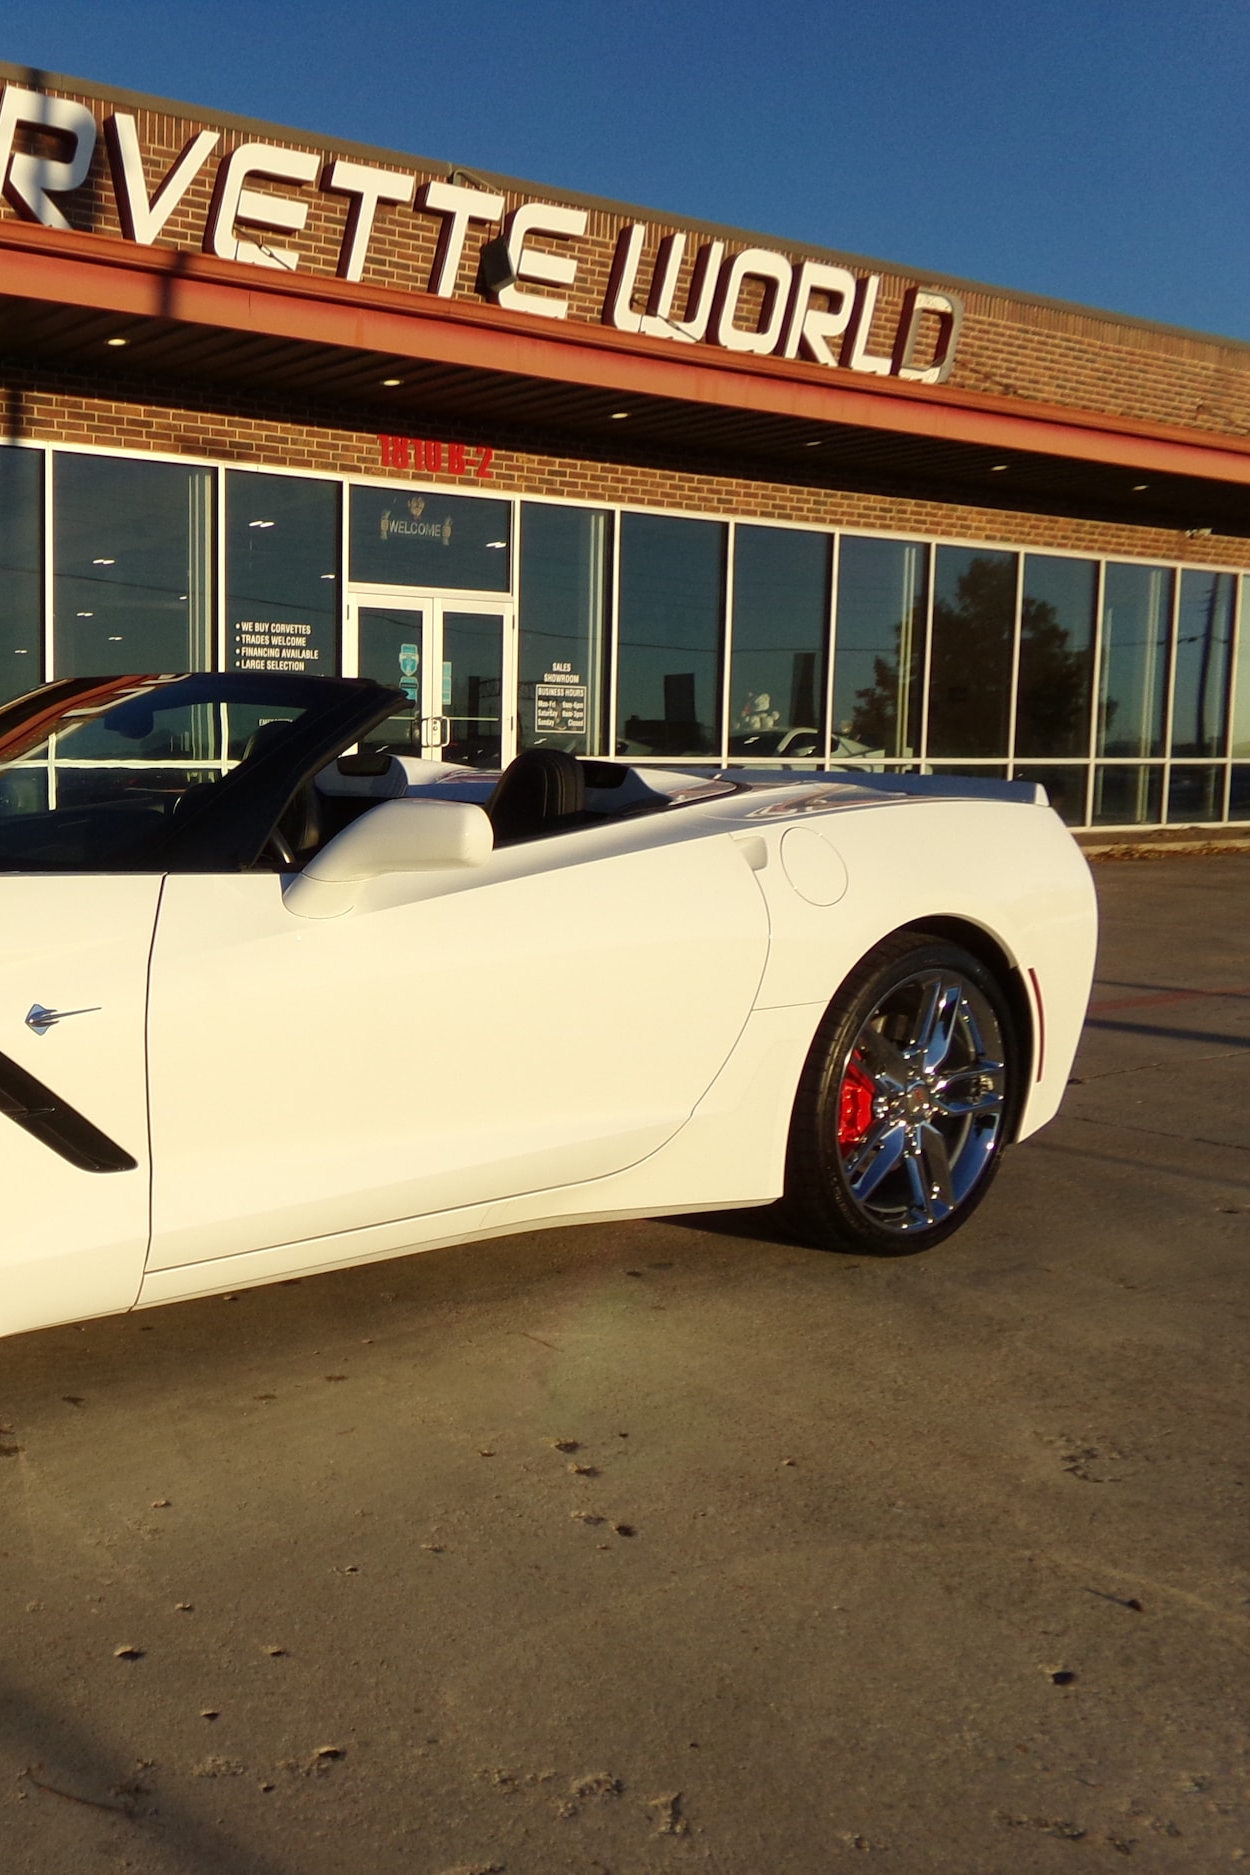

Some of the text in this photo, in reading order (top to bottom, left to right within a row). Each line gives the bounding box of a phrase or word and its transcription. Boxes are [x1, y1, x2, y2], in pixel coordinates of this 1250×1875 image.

[607, 222, 962, 384] WORLD
[377, 434, 494, 479] 1810 B-2
[389, 520, 441, 537] WELCOME
[241, 622, 311, 634] WE BUY CORVETTES
[241, 634, 306, 646] TRADES WELCOME
[241, 647, 318, 659] FINANCING AVAILABLE
[241, 659, 305, 671] LARGE SELECTION
[552, 662, 571, 672] SALES
[544, 673, 579, 683] SHOWROOM
[538, 688, 584, 697] BUSINESS HOURS
